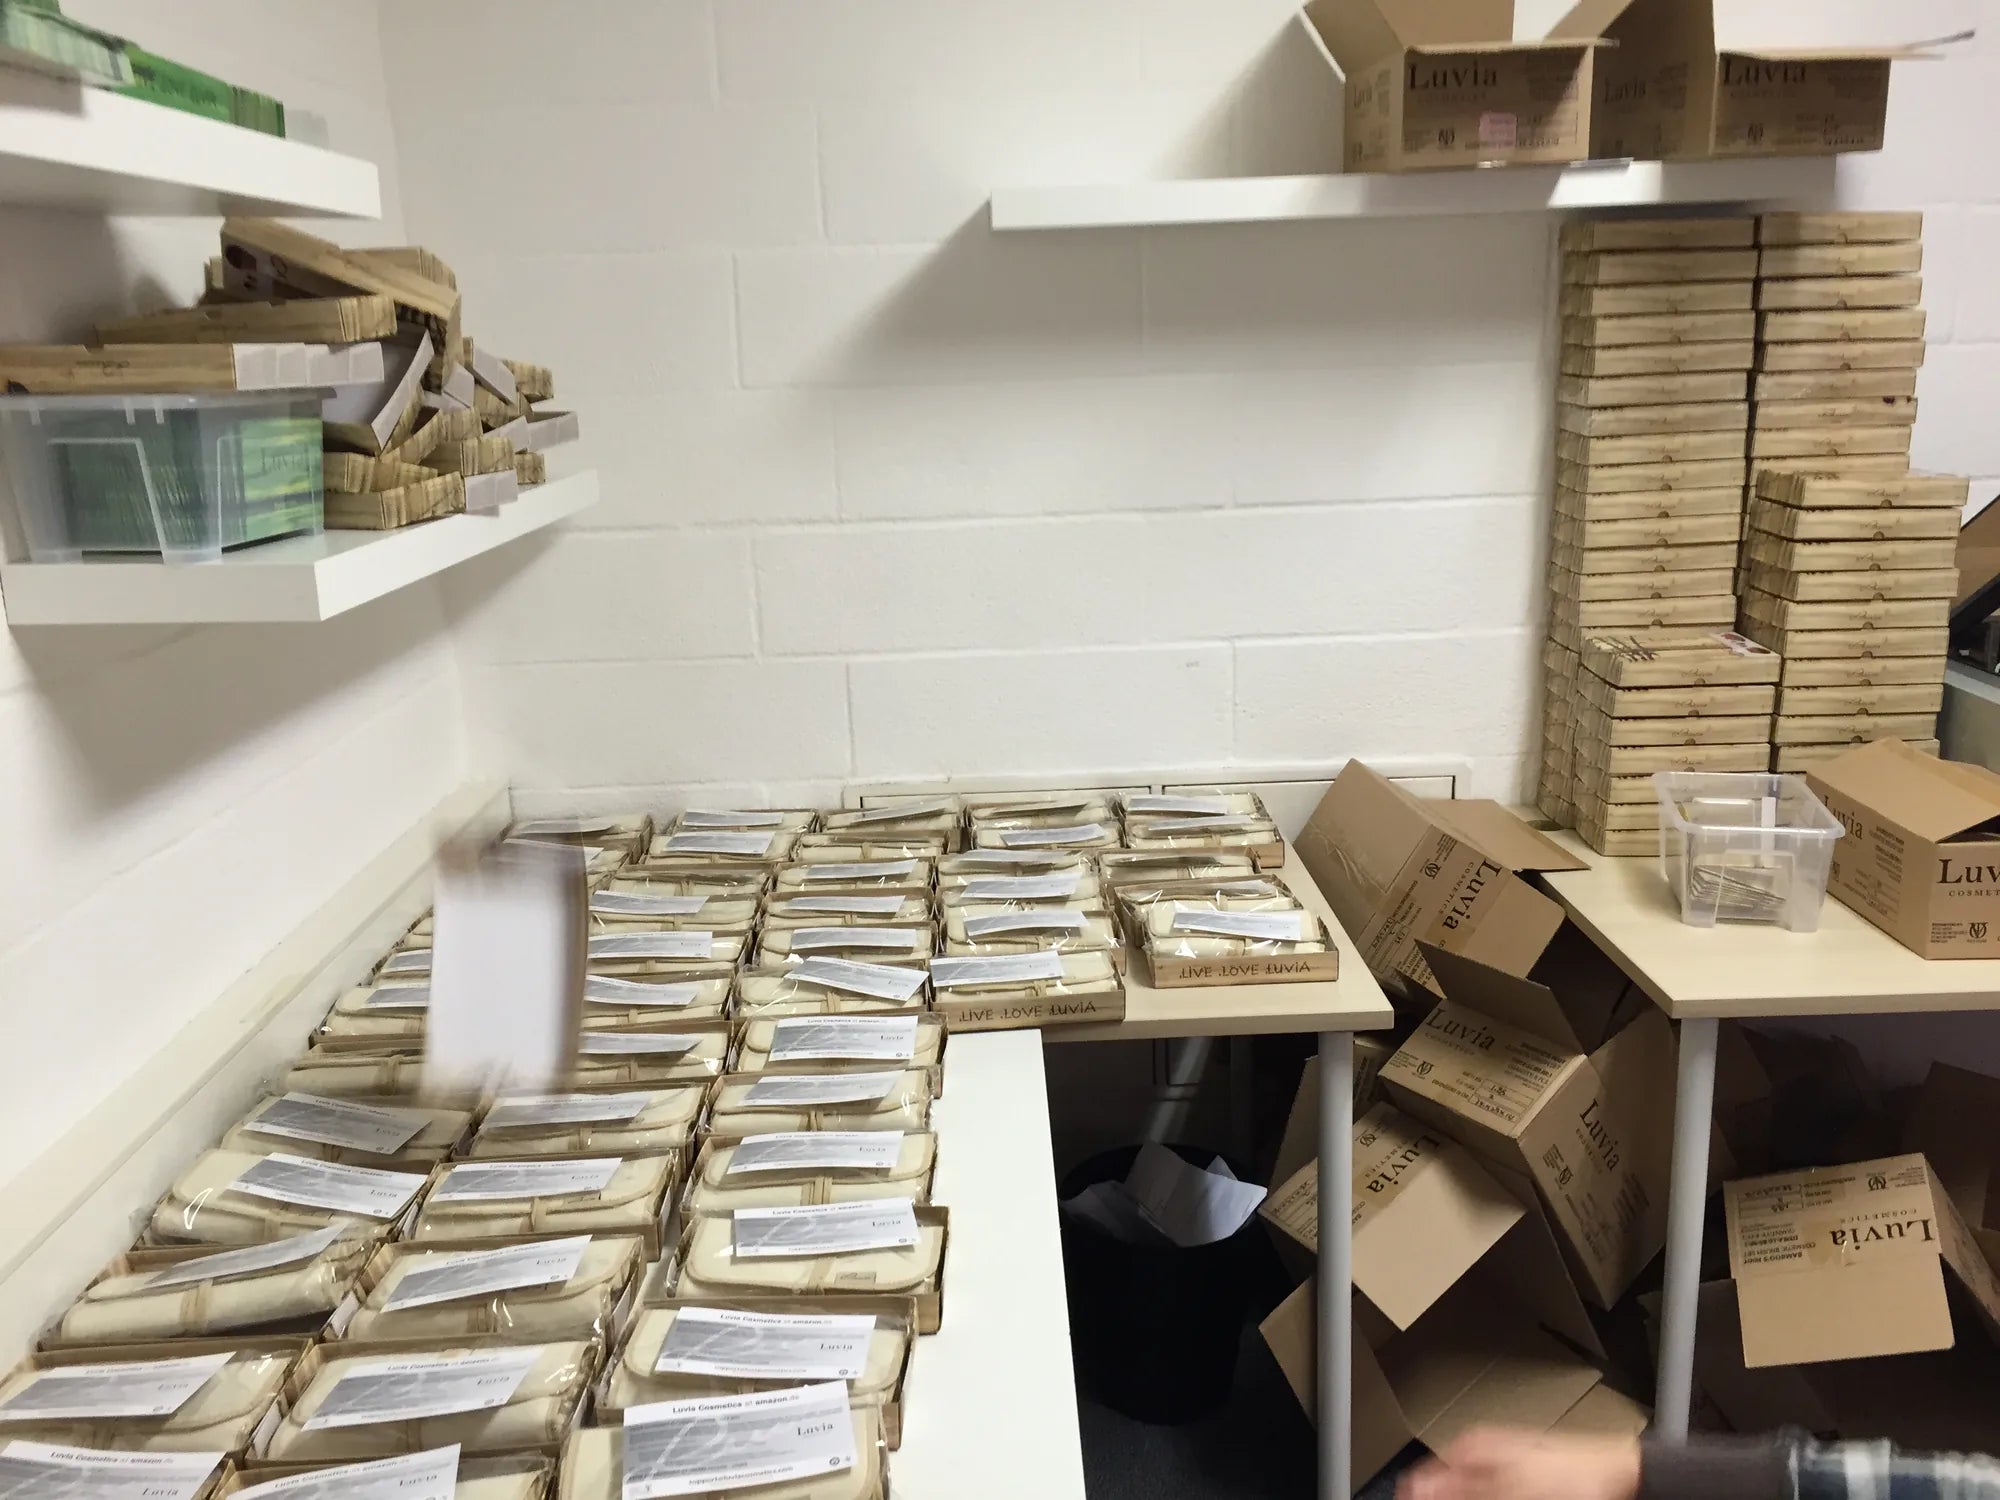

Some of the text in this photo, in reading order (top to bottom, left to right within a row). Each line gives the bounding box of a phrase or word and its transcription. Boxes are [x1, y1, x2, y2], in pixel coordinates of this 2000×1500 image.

[1408, 59, 1498, 90] Luvia
[1722, 58, 1807, 86] Luvia
[1442, 858, 1503, 930] Luvia
[1426, 1007, 1496, 1051] Luvia
[1579, 1098, 1620, 1172] Luvia
[1366, 1134, 1440, 1194] Luvia
[1830, 1218, 1935, 1251] Luvia
[672, 1405, 696, 1414] Luvia
[698, 1401, 743, 1412] Cosmetics
[797, 1421, 834, 1437] Luvia
[142, 1487, 179, 1497] Luvia
